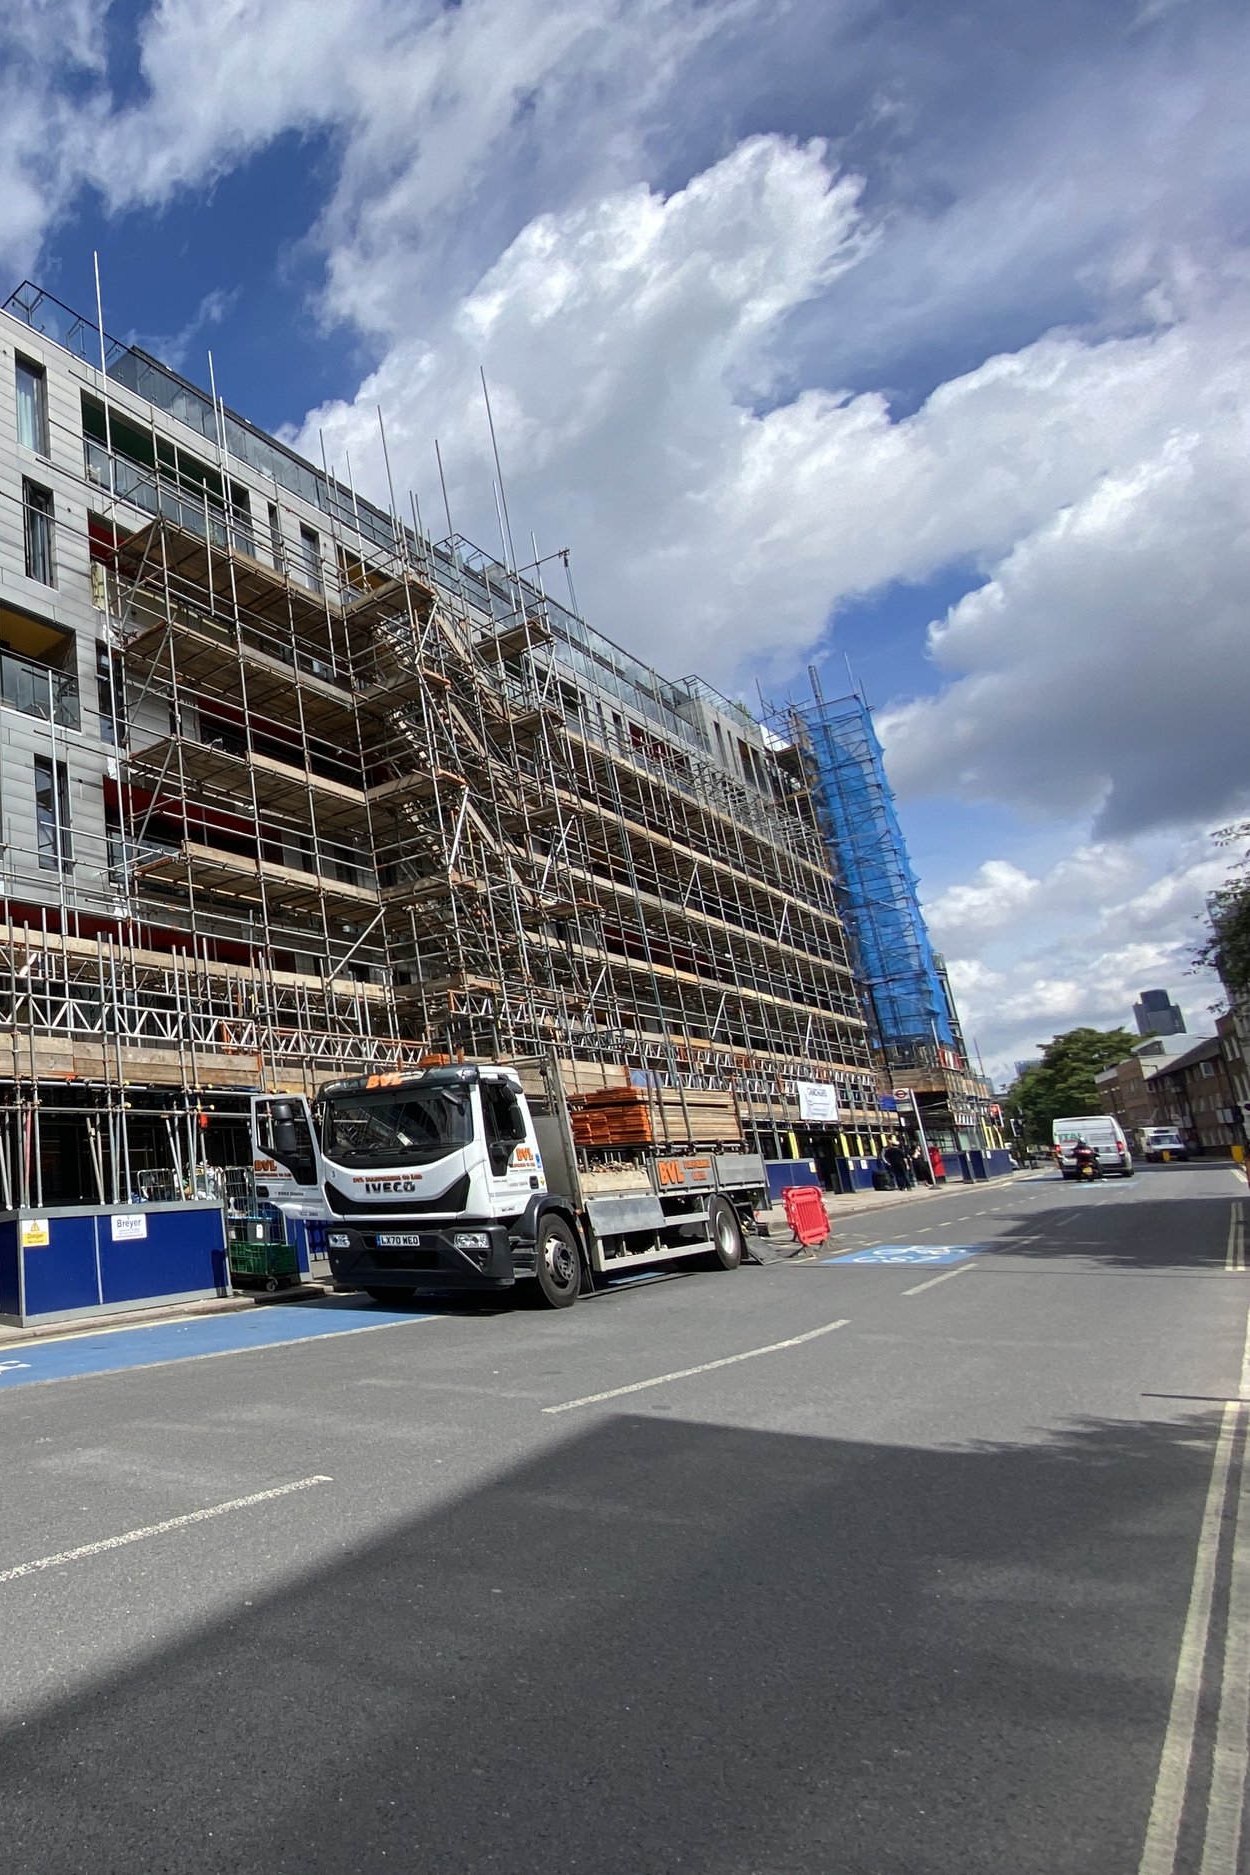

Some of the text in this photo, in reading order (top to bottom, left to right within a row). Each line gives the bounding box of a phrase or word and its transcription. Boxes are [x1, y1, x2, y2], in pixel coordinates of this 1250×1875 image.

[515, 1147, 534, 1161] BVL
[254, 1159, 278, 1172] BVL
[657, 1160, 685, 1185] BVL
[365, 1181, 416, 1194] IVECO
[116, 1219, 142, 1228] Breyer
[381, 1236, 401, 1245] LX70
